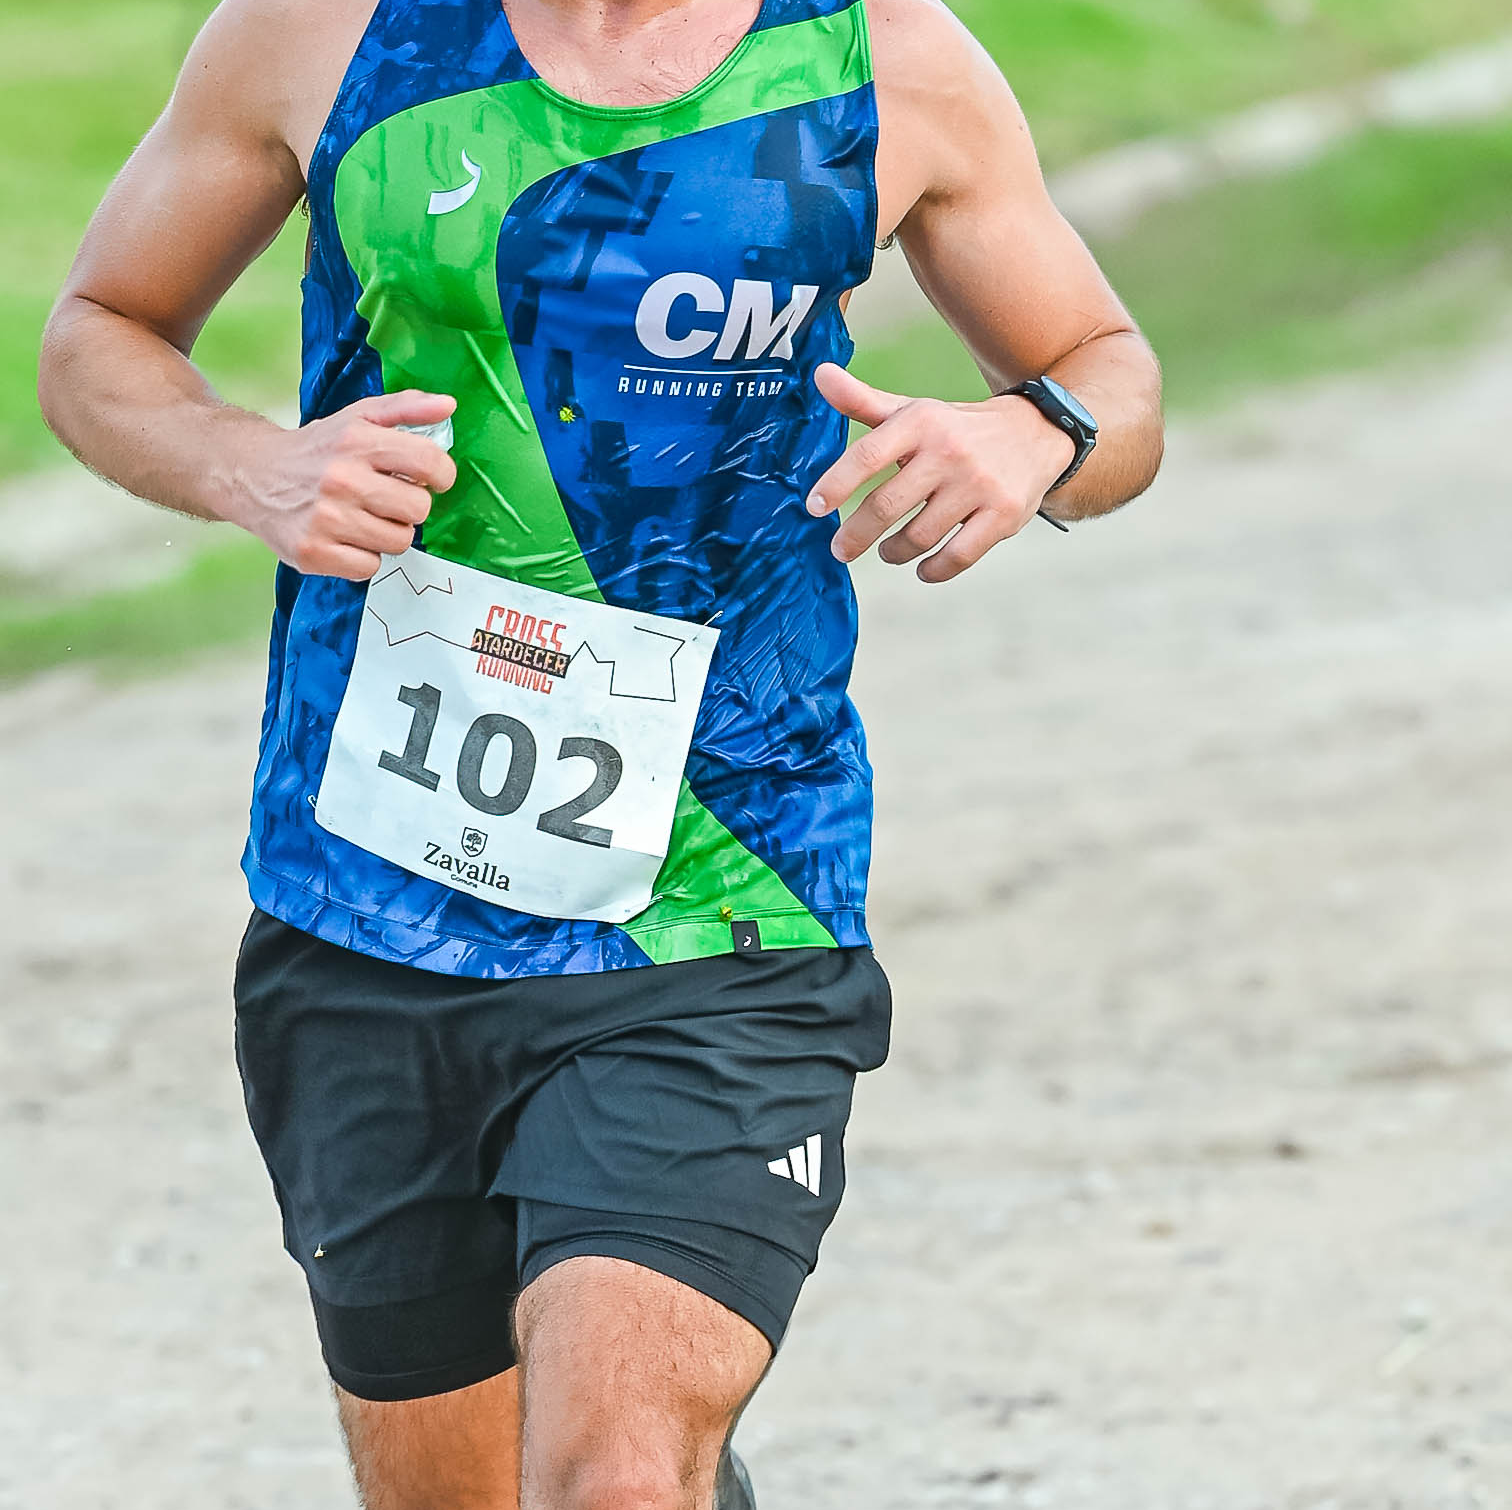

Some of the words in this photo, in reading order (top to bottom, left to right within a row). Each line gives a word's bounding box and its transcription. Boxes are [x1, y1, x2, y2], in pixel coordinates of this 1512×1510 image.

[635, 271, 820, 361] CM
[618, 376, 723, 397] RUNNING
[736, 380, 783, 397] TEAM
[485, 605, 567, 652] CROSS
[471, 630, 569, 676] ATARDECER
[476, 654, 554, 695] RUNNING
[377, 682, 623, 849] 102
[423, 841, 510, 891] Zavalla
